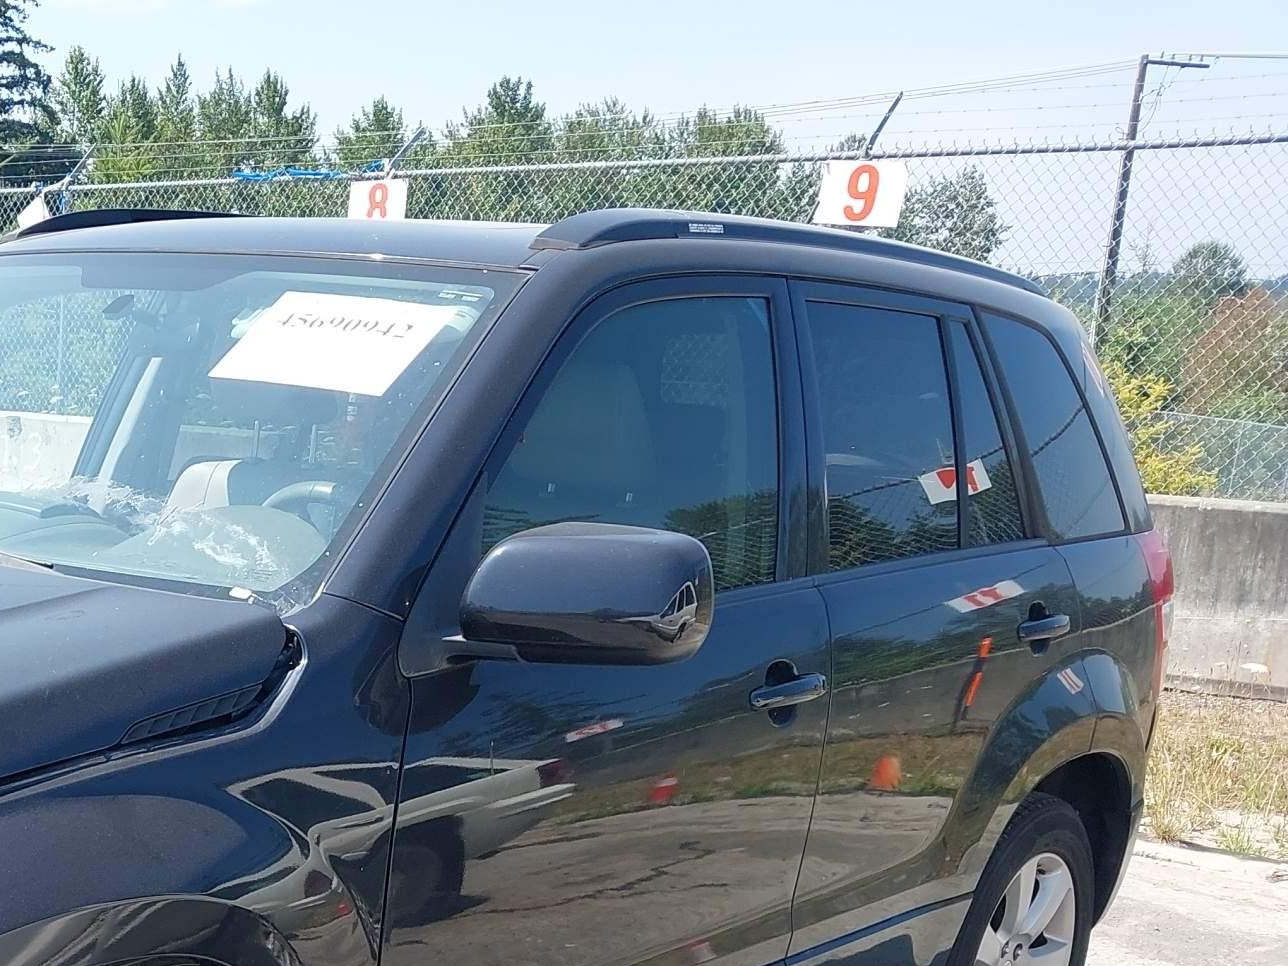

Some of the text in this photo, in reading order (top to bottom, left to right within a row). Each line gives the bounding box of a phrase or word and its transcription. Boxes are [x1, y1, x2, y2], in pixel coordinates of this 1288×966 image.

[367, 183, 389, 218] 8
[844, 164, 880, 222] 9
[276, 312, 415, 340] 45690942
